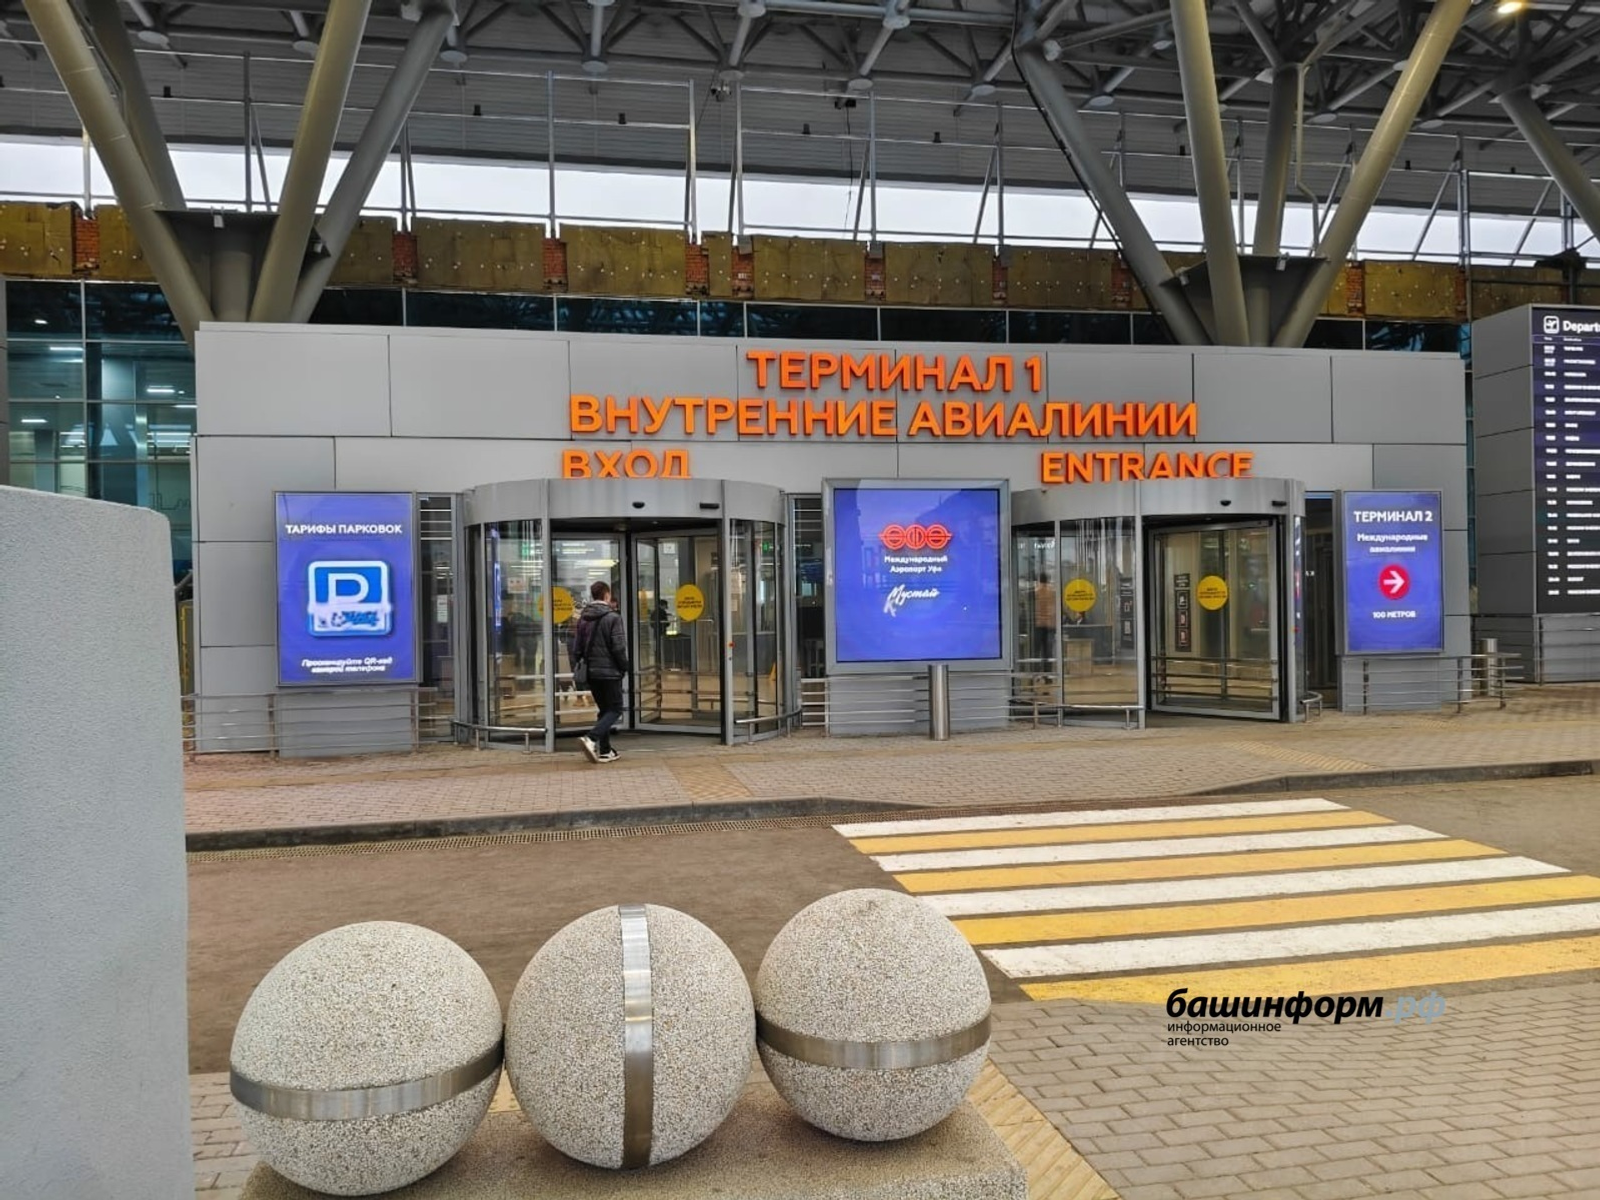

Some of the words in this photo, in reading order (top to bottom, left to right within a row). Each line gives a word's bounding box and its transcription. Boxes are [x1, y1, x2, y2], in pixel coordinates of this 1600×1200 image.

[746, 351, 1014, 392] ТЕРМИНАЛ
[1024, 354, 1042, 392] 1
[570, 394, 897, 436] ВНУТРЕННИЕ
[908, 400, 1197, 437] АВИАЛИНИИ
[563, 449, 691, 479] ВХОД
[1041, 451, 1254, 484] ENTRANCE
[285, 524, 336, 534] ТАРИФЫ
[338, 524, 403, 534] ПАРКОВОК
[1354, 511, 1423, 522] ТЕРМИНАЛ
[1425, 511, 1433, 522] 2
[1372, 611, 1386, 619] 100
[1387, 610, 1416, 618] МЕТРОВ
